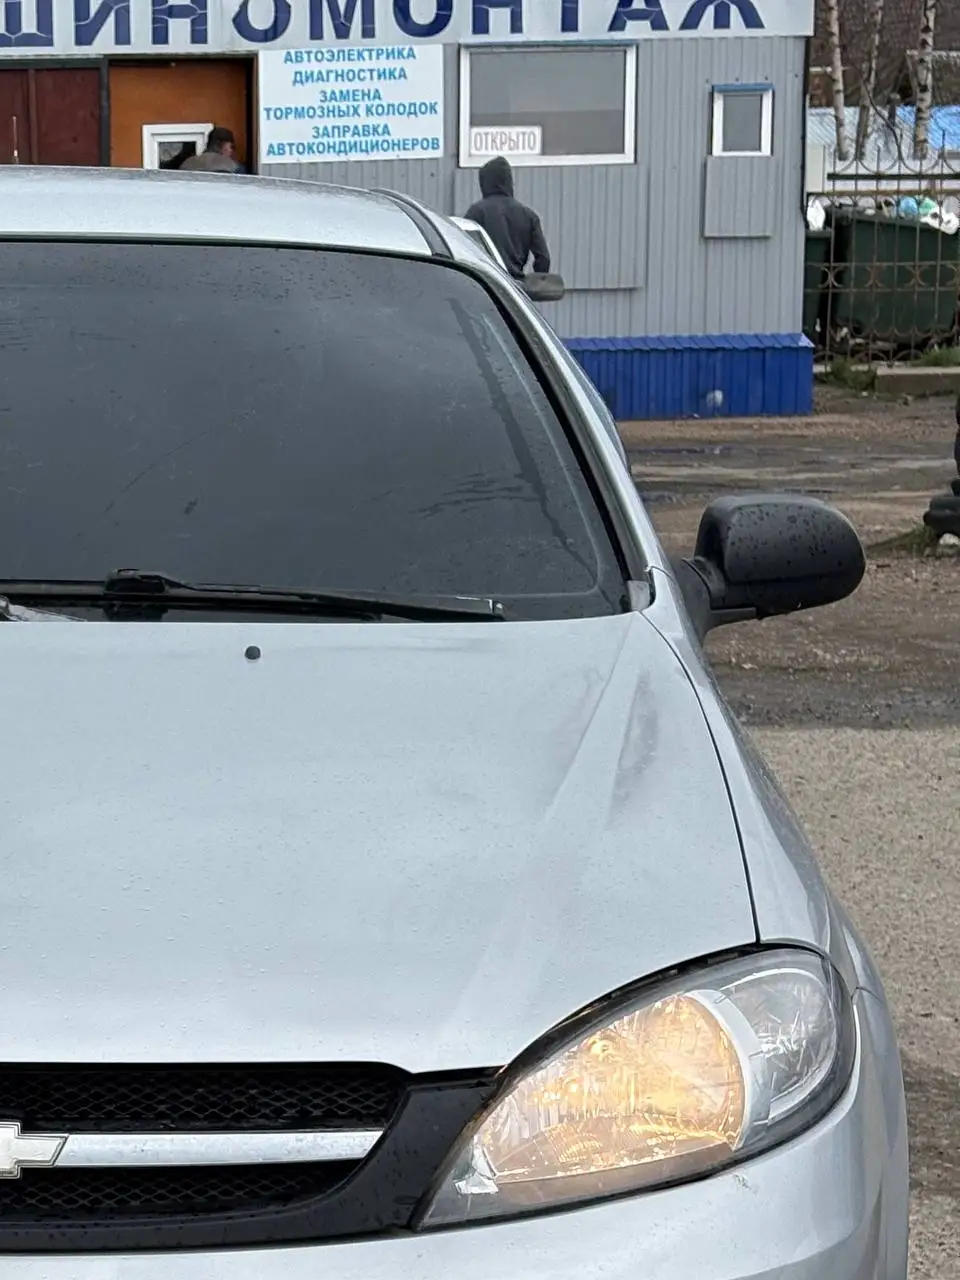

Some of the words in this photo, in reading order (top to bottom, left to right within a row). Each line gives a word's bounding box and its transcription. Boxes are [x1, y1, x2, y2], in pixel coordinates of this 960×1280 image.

[283, 45, 417, 65] АВТОЭЛЕКТРИКА
[292, 67, 408, 87] ДИАГНОСТИКА
[319, 88, 383, 103] ЗАМЕНА
[263, 104, 361, 121] ТОРМОЗНЫХ
[365, 101, 438, 118] КОЛОДОК
[311, 123, 391, 139] ЗАПРАВКА
[473, 130, 537, 152] ОТКРЫТО
[266, 137, 440, 157] АВТОКОНДИЦИОНЕРОВ
